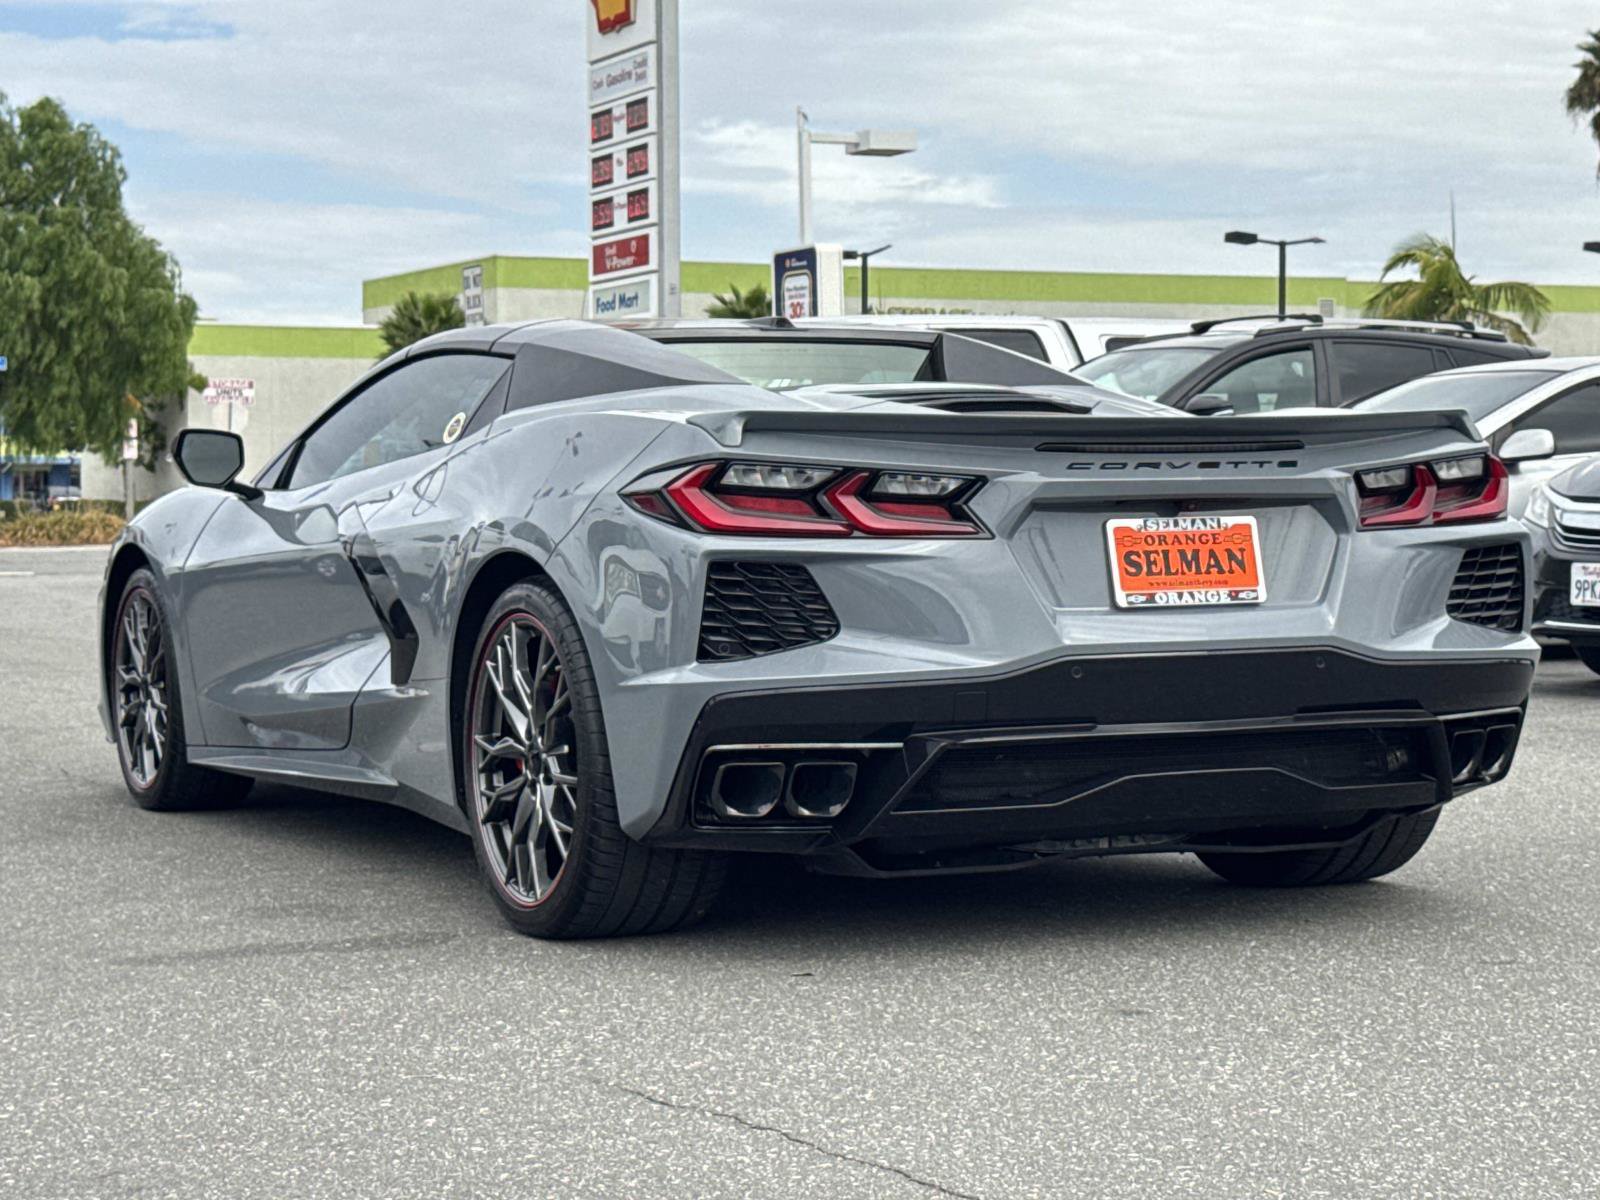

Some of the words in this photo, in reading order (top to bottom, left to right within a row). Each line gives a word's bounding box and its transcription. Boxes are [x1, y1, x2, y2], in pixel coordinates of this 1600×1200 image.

[596, 292, 616, 314] Food
[619, 292, 638, 310] Mart
[1066, 460, 1298, 470] CORVETTE
[1145, 518, 1219, 531] SELMAN
[1143, 532, 1223, 547] ORANGE
[1122, 547, 1247, 578] SELMAN
[1575, 579, 1600, 599] 9PK
[1154, 591, 1231, 605] ORANGE
